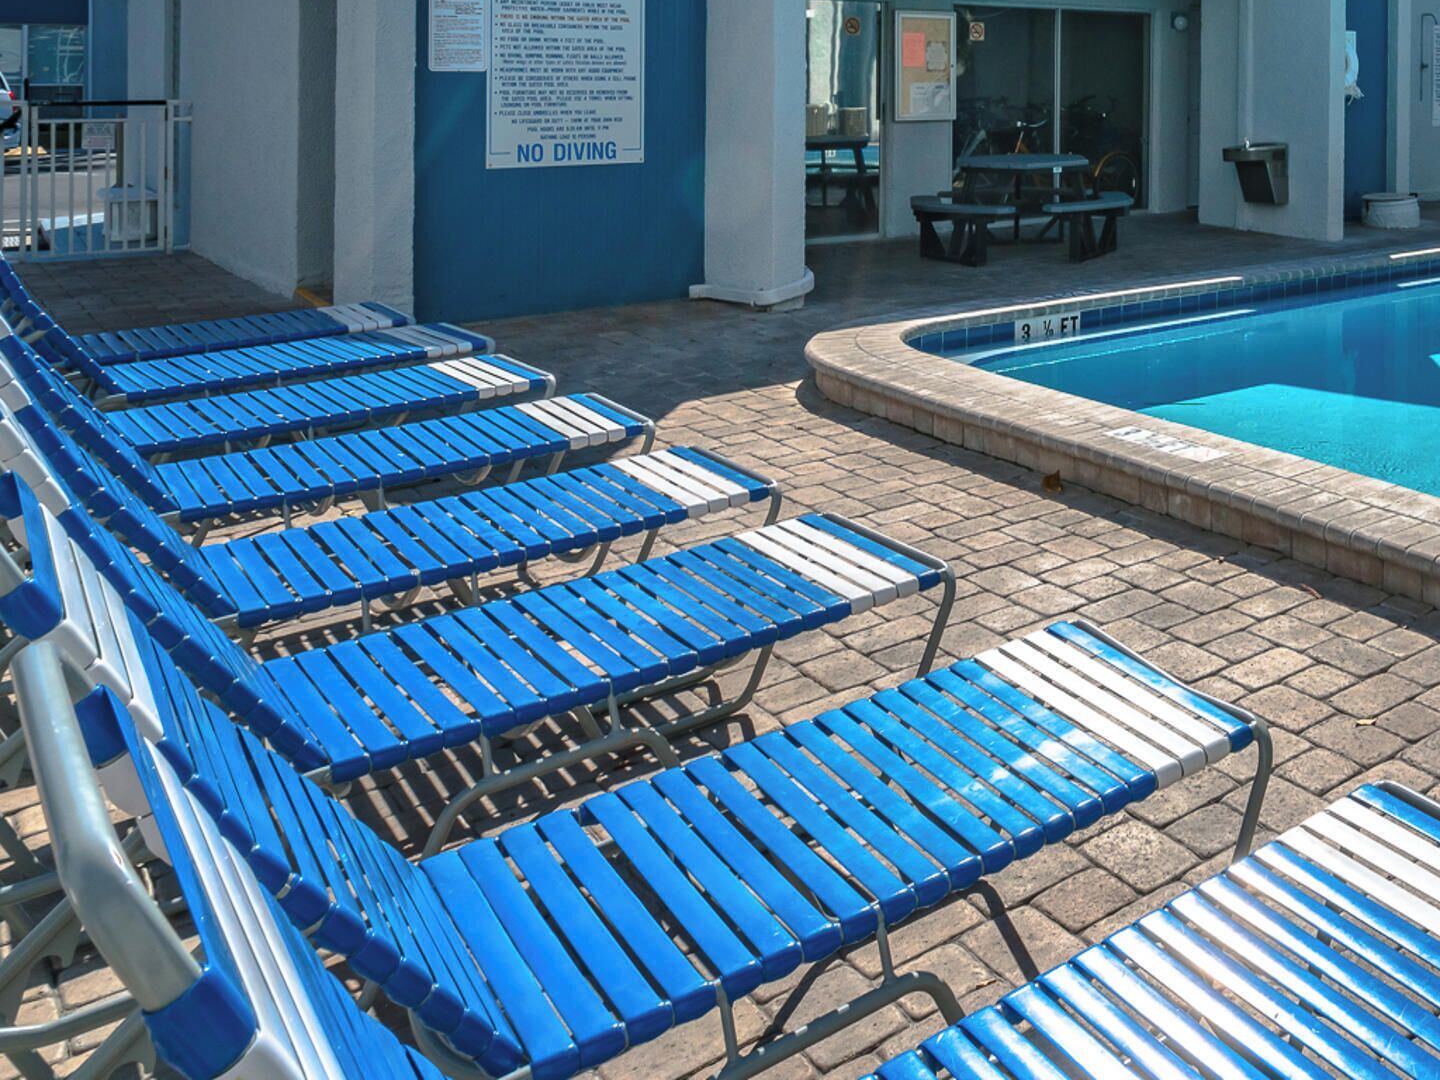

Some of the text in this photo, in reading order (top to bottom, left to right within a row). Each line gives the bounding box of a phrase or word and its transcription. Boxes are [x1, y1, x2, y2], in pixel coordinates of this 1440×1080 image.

[517, 141, 617, 163] NO DIVING
[1021, 323, 1031, 341] 3
[1061, 315, 1079, 336] FT
